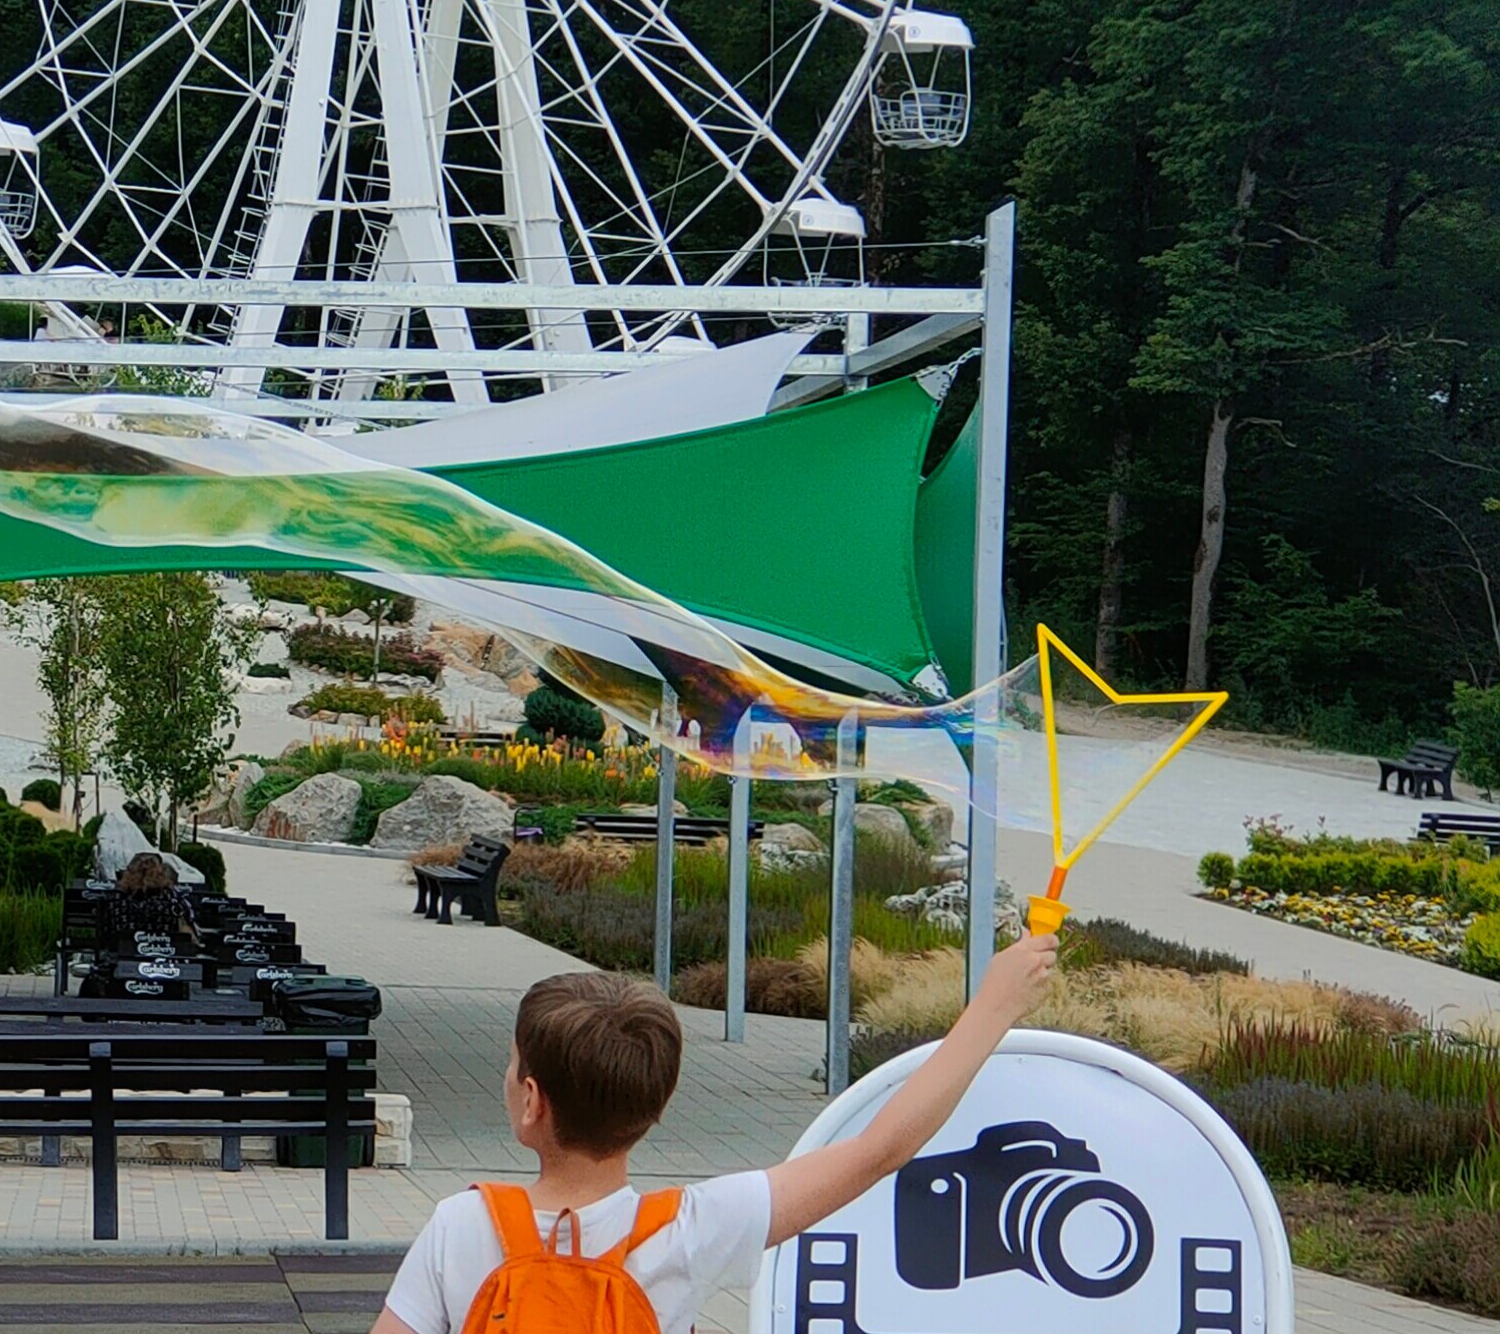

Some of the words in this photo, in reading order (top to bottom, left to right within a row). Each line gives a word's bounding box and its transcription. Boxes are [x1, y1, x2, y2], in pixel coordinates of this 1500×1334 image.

[138, 943, 176, 958] Carlsberg
[138, 962, 180, 979] Carlsberg
[125, 980, 164, 995] Carlsberg
